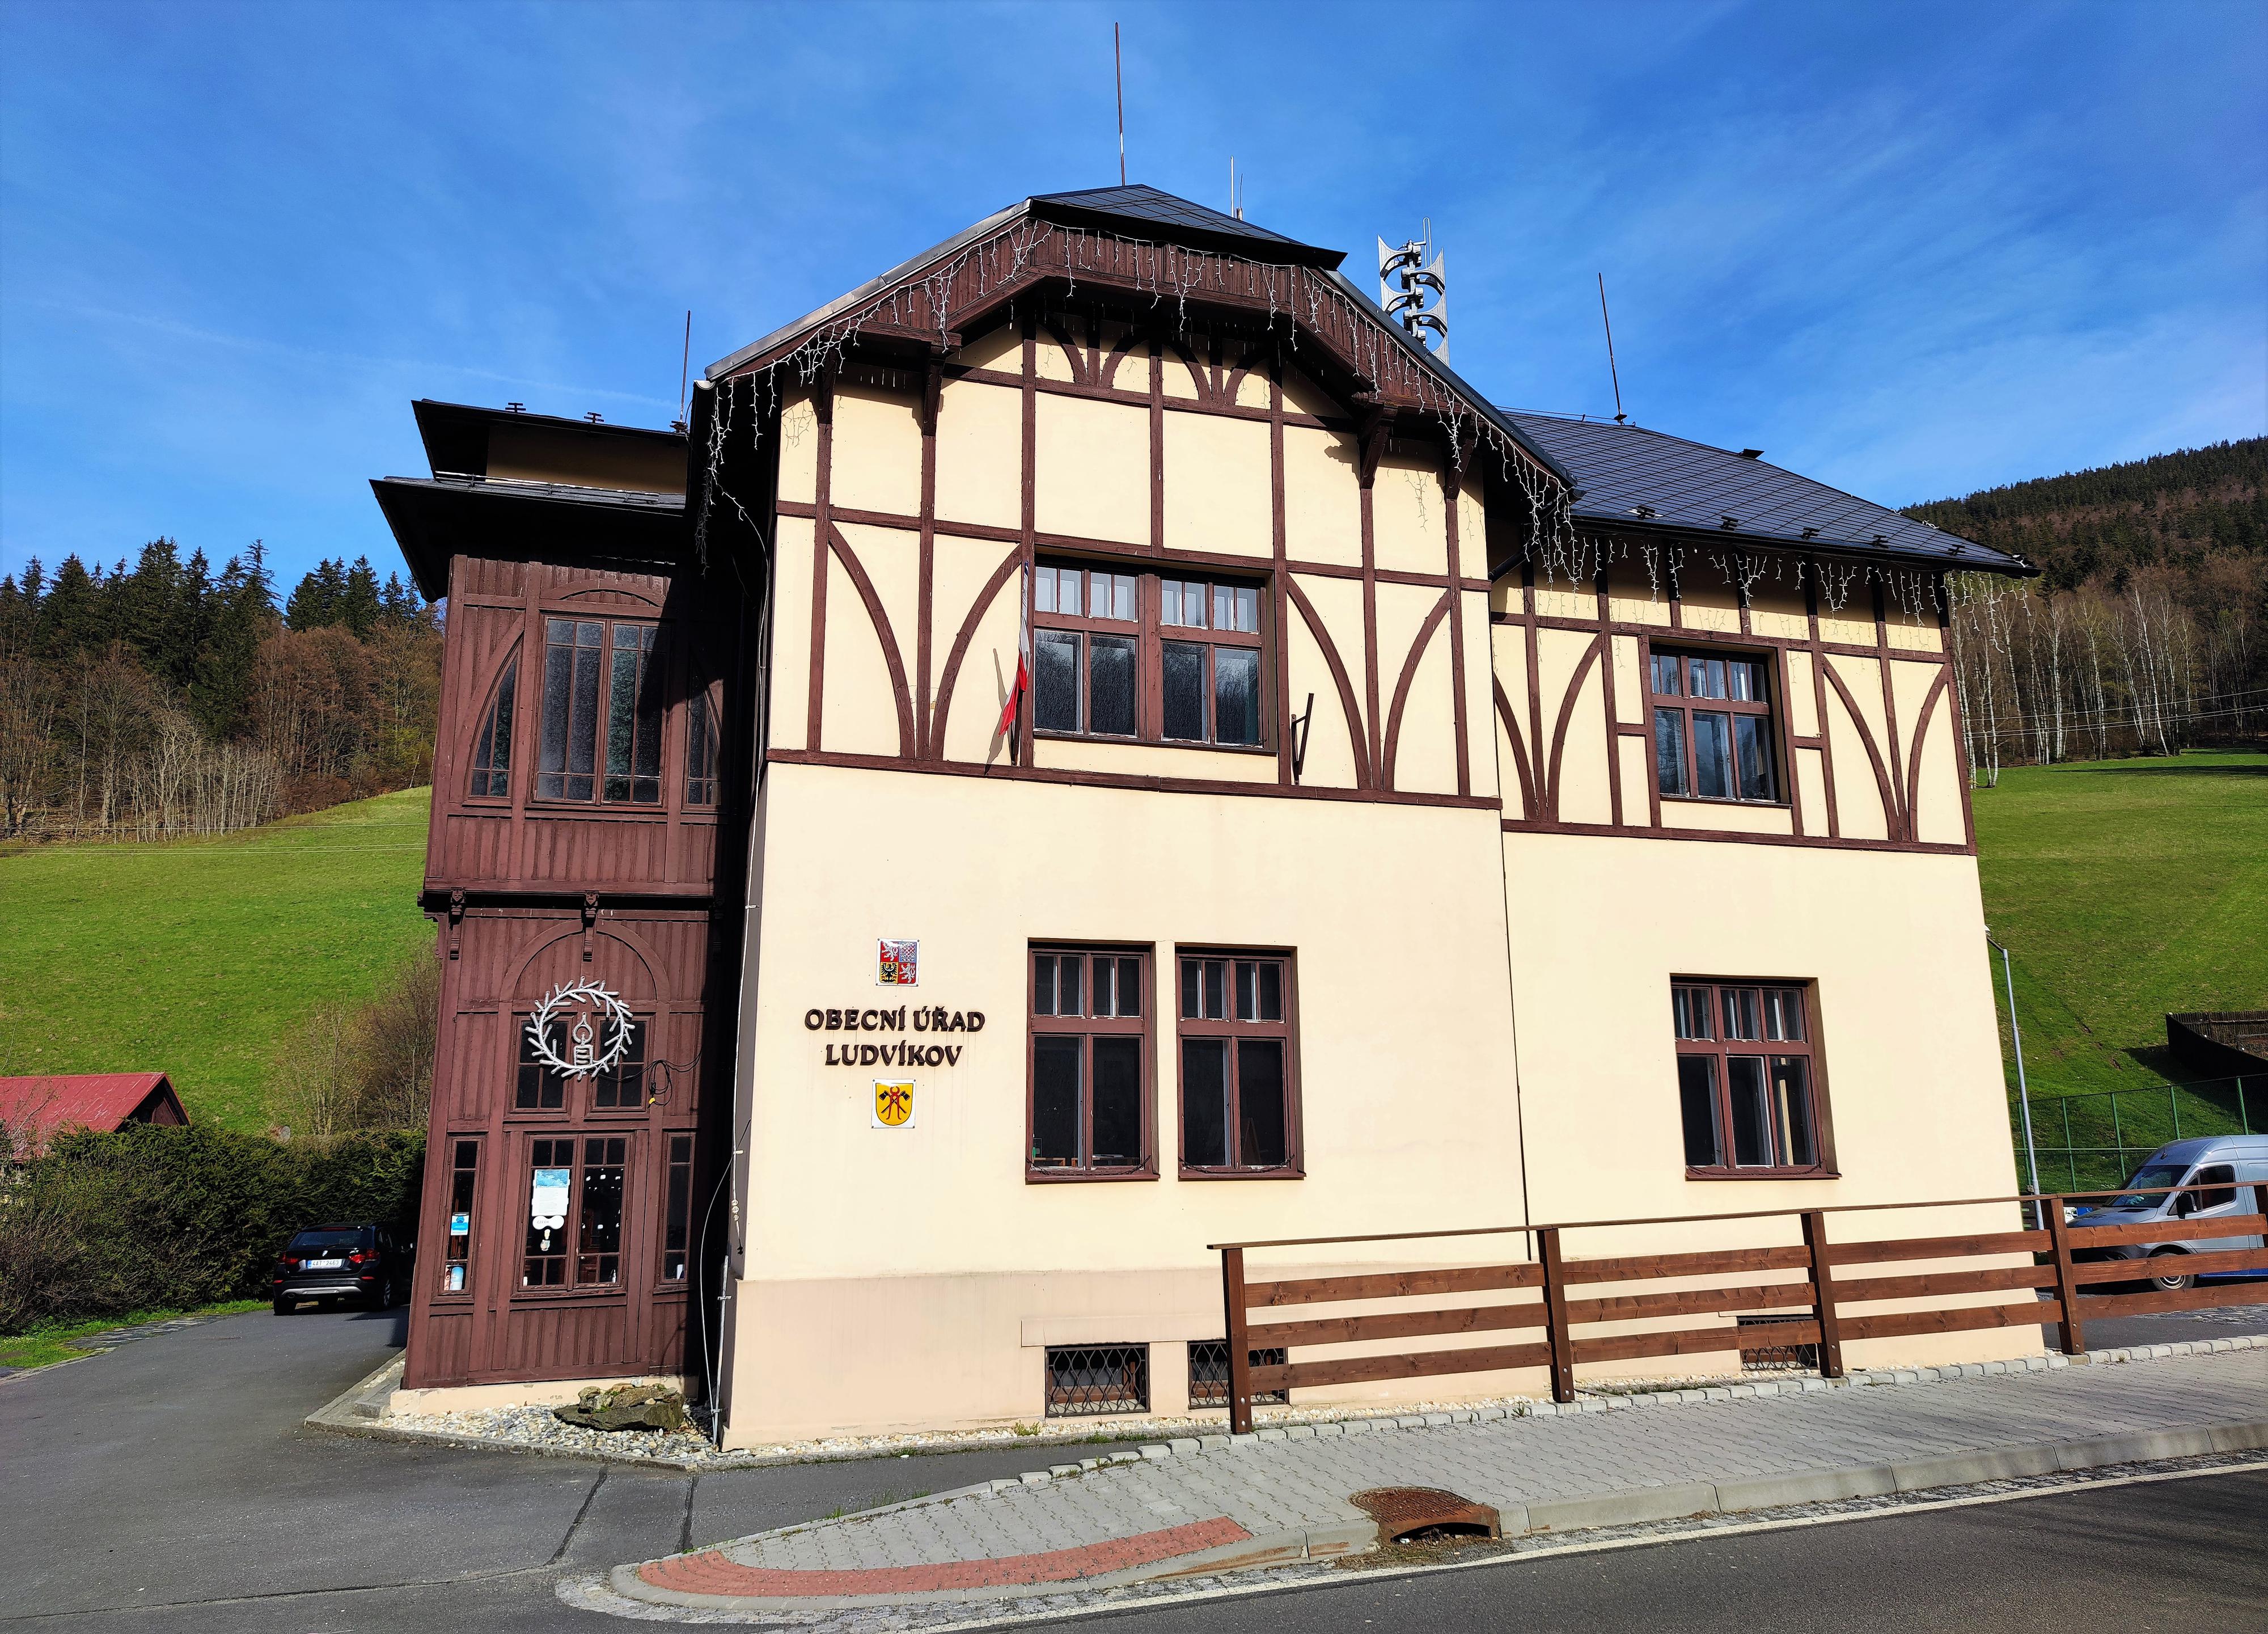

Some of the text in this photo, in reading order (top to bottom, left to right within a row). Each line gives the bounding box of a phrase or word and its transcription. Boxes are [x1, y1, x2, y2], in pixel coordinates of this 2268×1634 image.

[805, 1006, 985, 1032] OBECNÍ ÚŘAD
[825, 1040, 963, 1067] LUDVÍKOV
